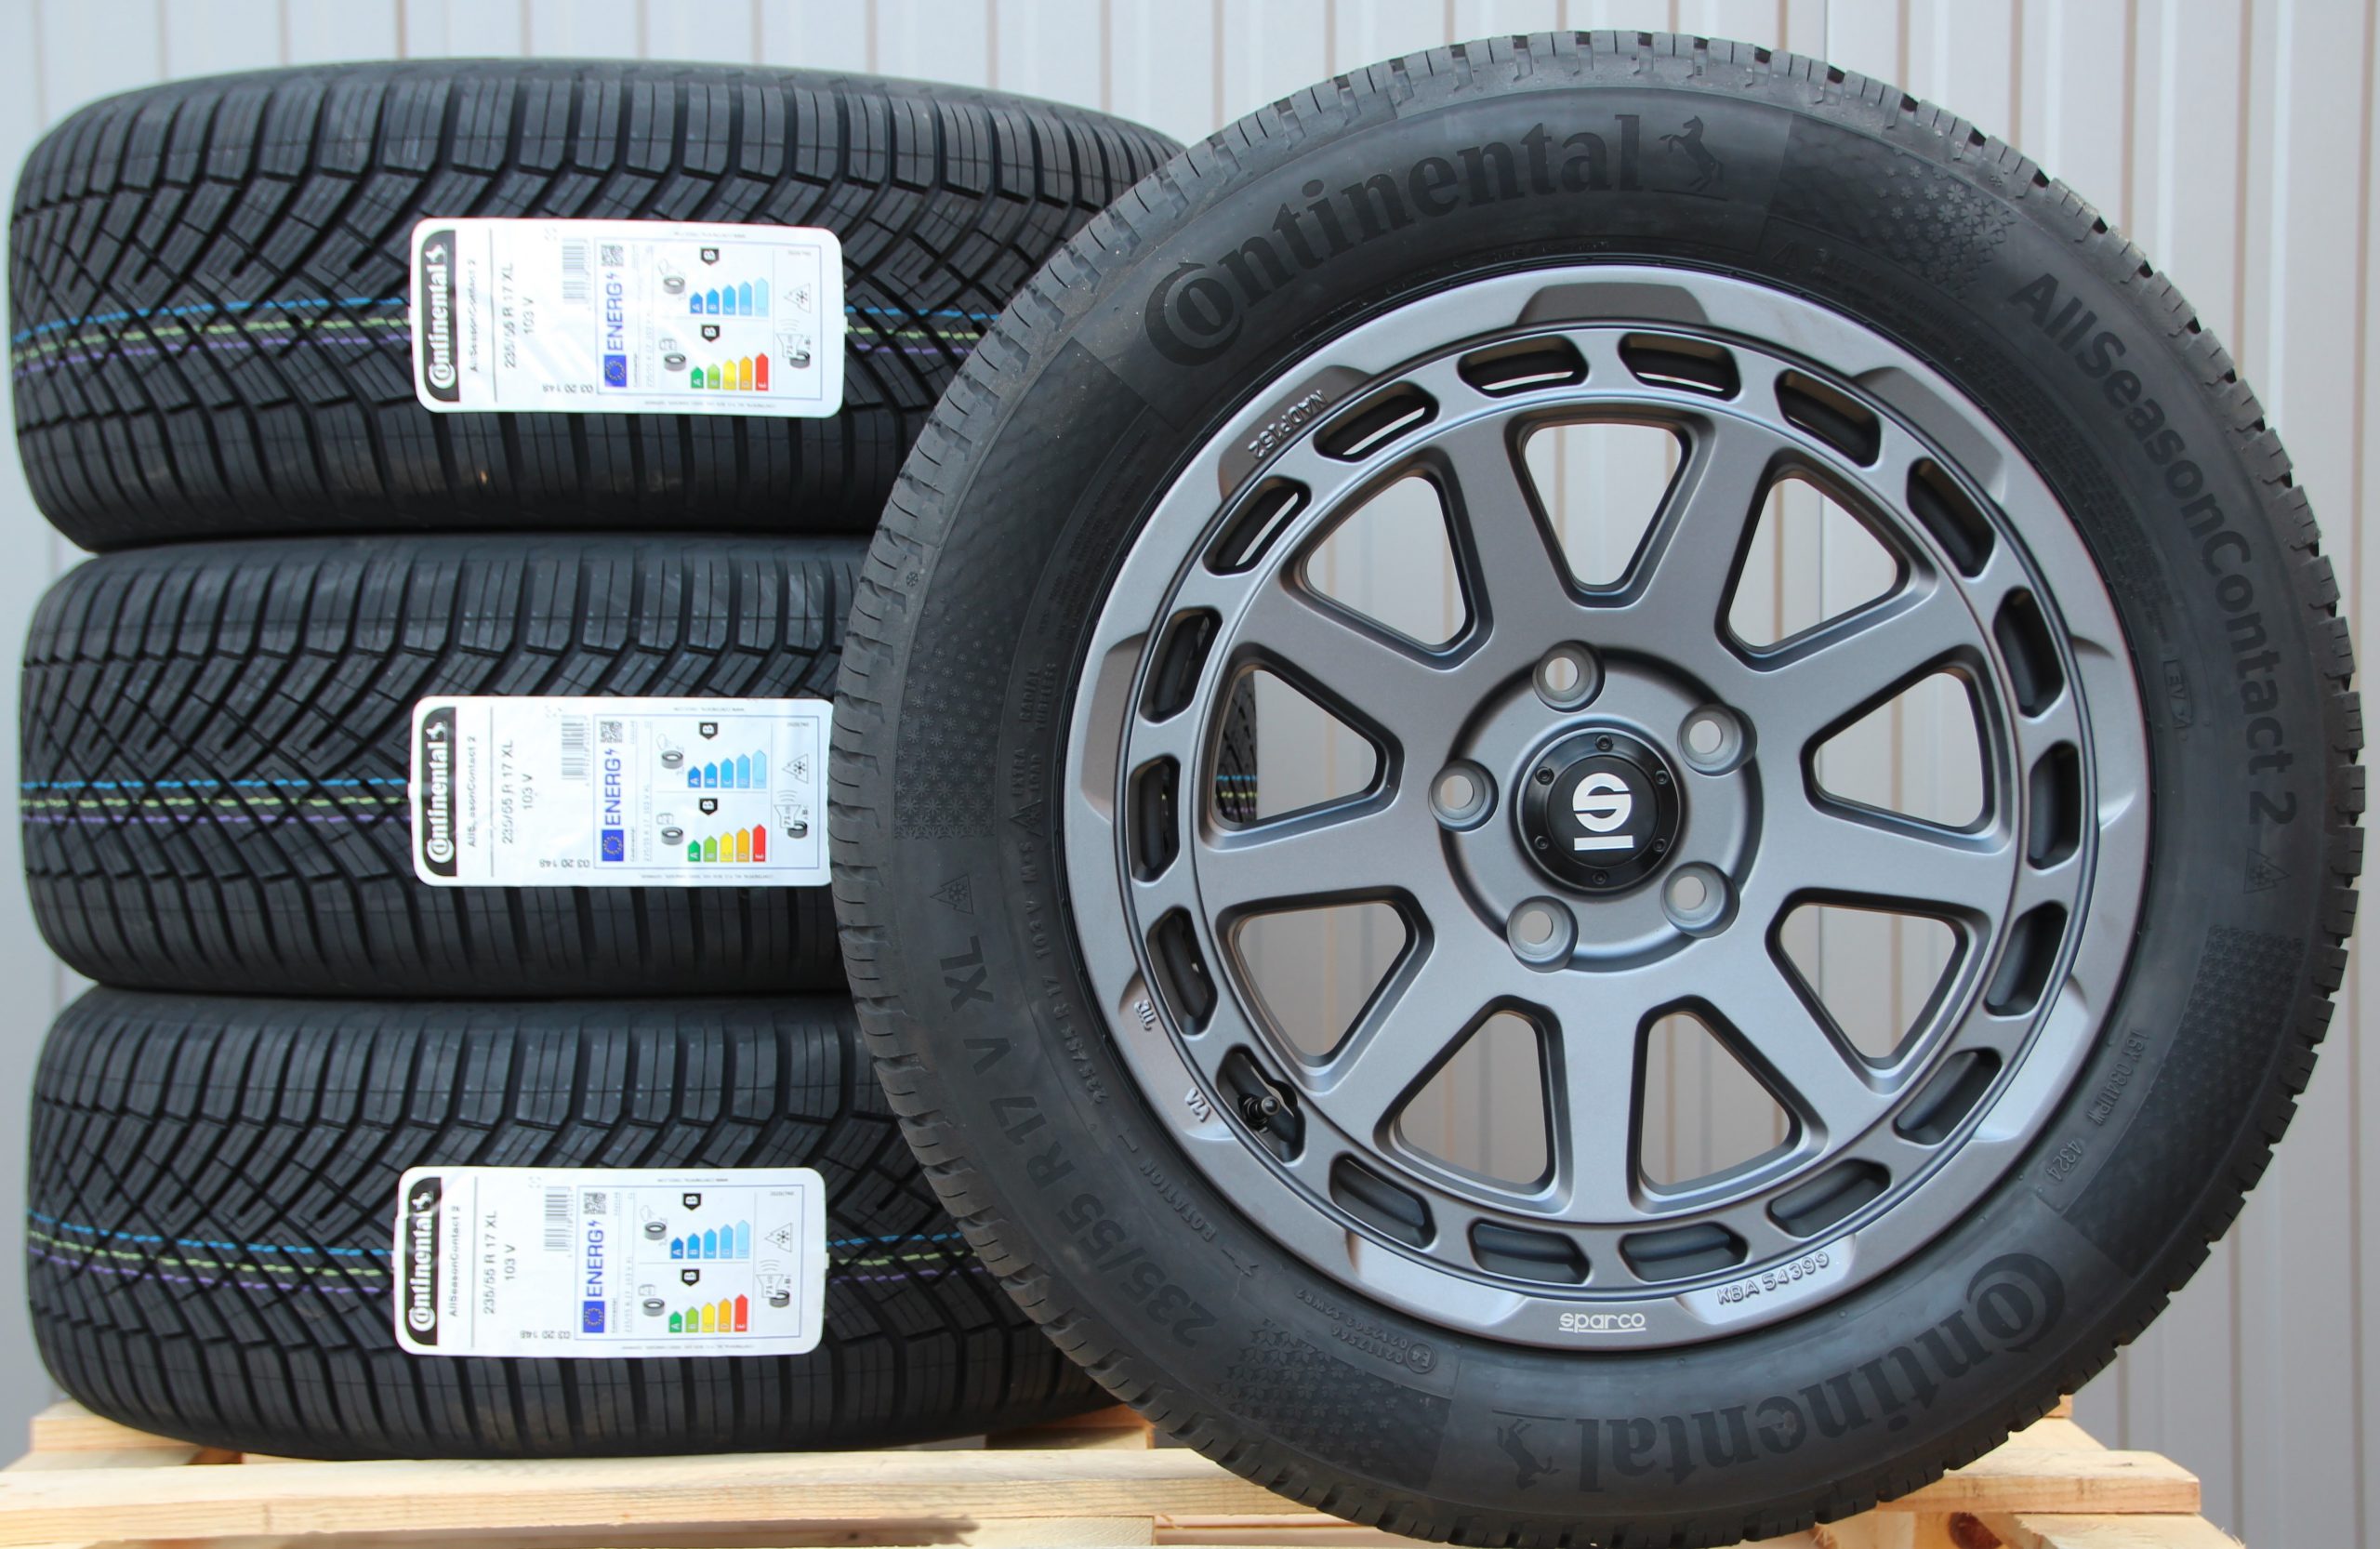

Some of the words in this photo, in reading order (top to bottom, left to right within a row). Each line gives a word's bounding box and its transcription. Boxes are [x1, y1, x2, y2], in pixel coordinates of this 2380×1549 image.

[1144, 113, 1642, 366] Continental
[705, 250, 716, 260] B
[501, 263, 513, 283] XL
[503, 286, 513, 301] 17
[522, 297, 534, 307] V
[502, 307, 514, 318] R
[426, 265, 456, 389] Continental
[705, 326, 716, 337] B
[2008, 272, 2294, 776] AllSeasonContact
[2249, 790, 2298, 827] 2
[702, 724, 714, 734] B
[501, 740, 512, 758] XL
[501, 763, 512, 778] 17
[522, 774, 532, 783] V
[501, 784, 512, 794] R
[522, 788, 533, 810] 103
[426, 742, 454, 864] Continental
[703, 800, 714, 809] B
[501, 798, 513, 844] 235/55
[939, 936, 995, 1014] XL
[963, 1037, 1011, 1077] V
[988, 1094, 1053, 1147] 17
[2046, 1140, 2082, 1182] 4324
[1025, 1153, 1077, 1192] R
[685, 1196, 698, 1205] B
[1139, 1158, 1218, 1242] ROTATION
[484, 1211, 496, 1228] XL
[484, 1234, 496, 1248] 17
[505, 1243, 515, 1253] V
[448, 1216, 460, 1317] AllSeasonContact
[484, 1254, 496, 1264] R
[505, 1257, 515, 1280] 103
[408, 1211, 436, 1331] Continental
[683, 1272, 696, 1281] B
[1058, 1193, 1219, 1348] 235/55
[1717, 1279, 1760, 1305] KBA
[1765, 1251, 1831, 1292] 54399
[483, 1268, 496, 1315] 235/55
[1559, 1312, 1646, 1333] sparco
[1574, 1251, 2067, 1492] Continental
